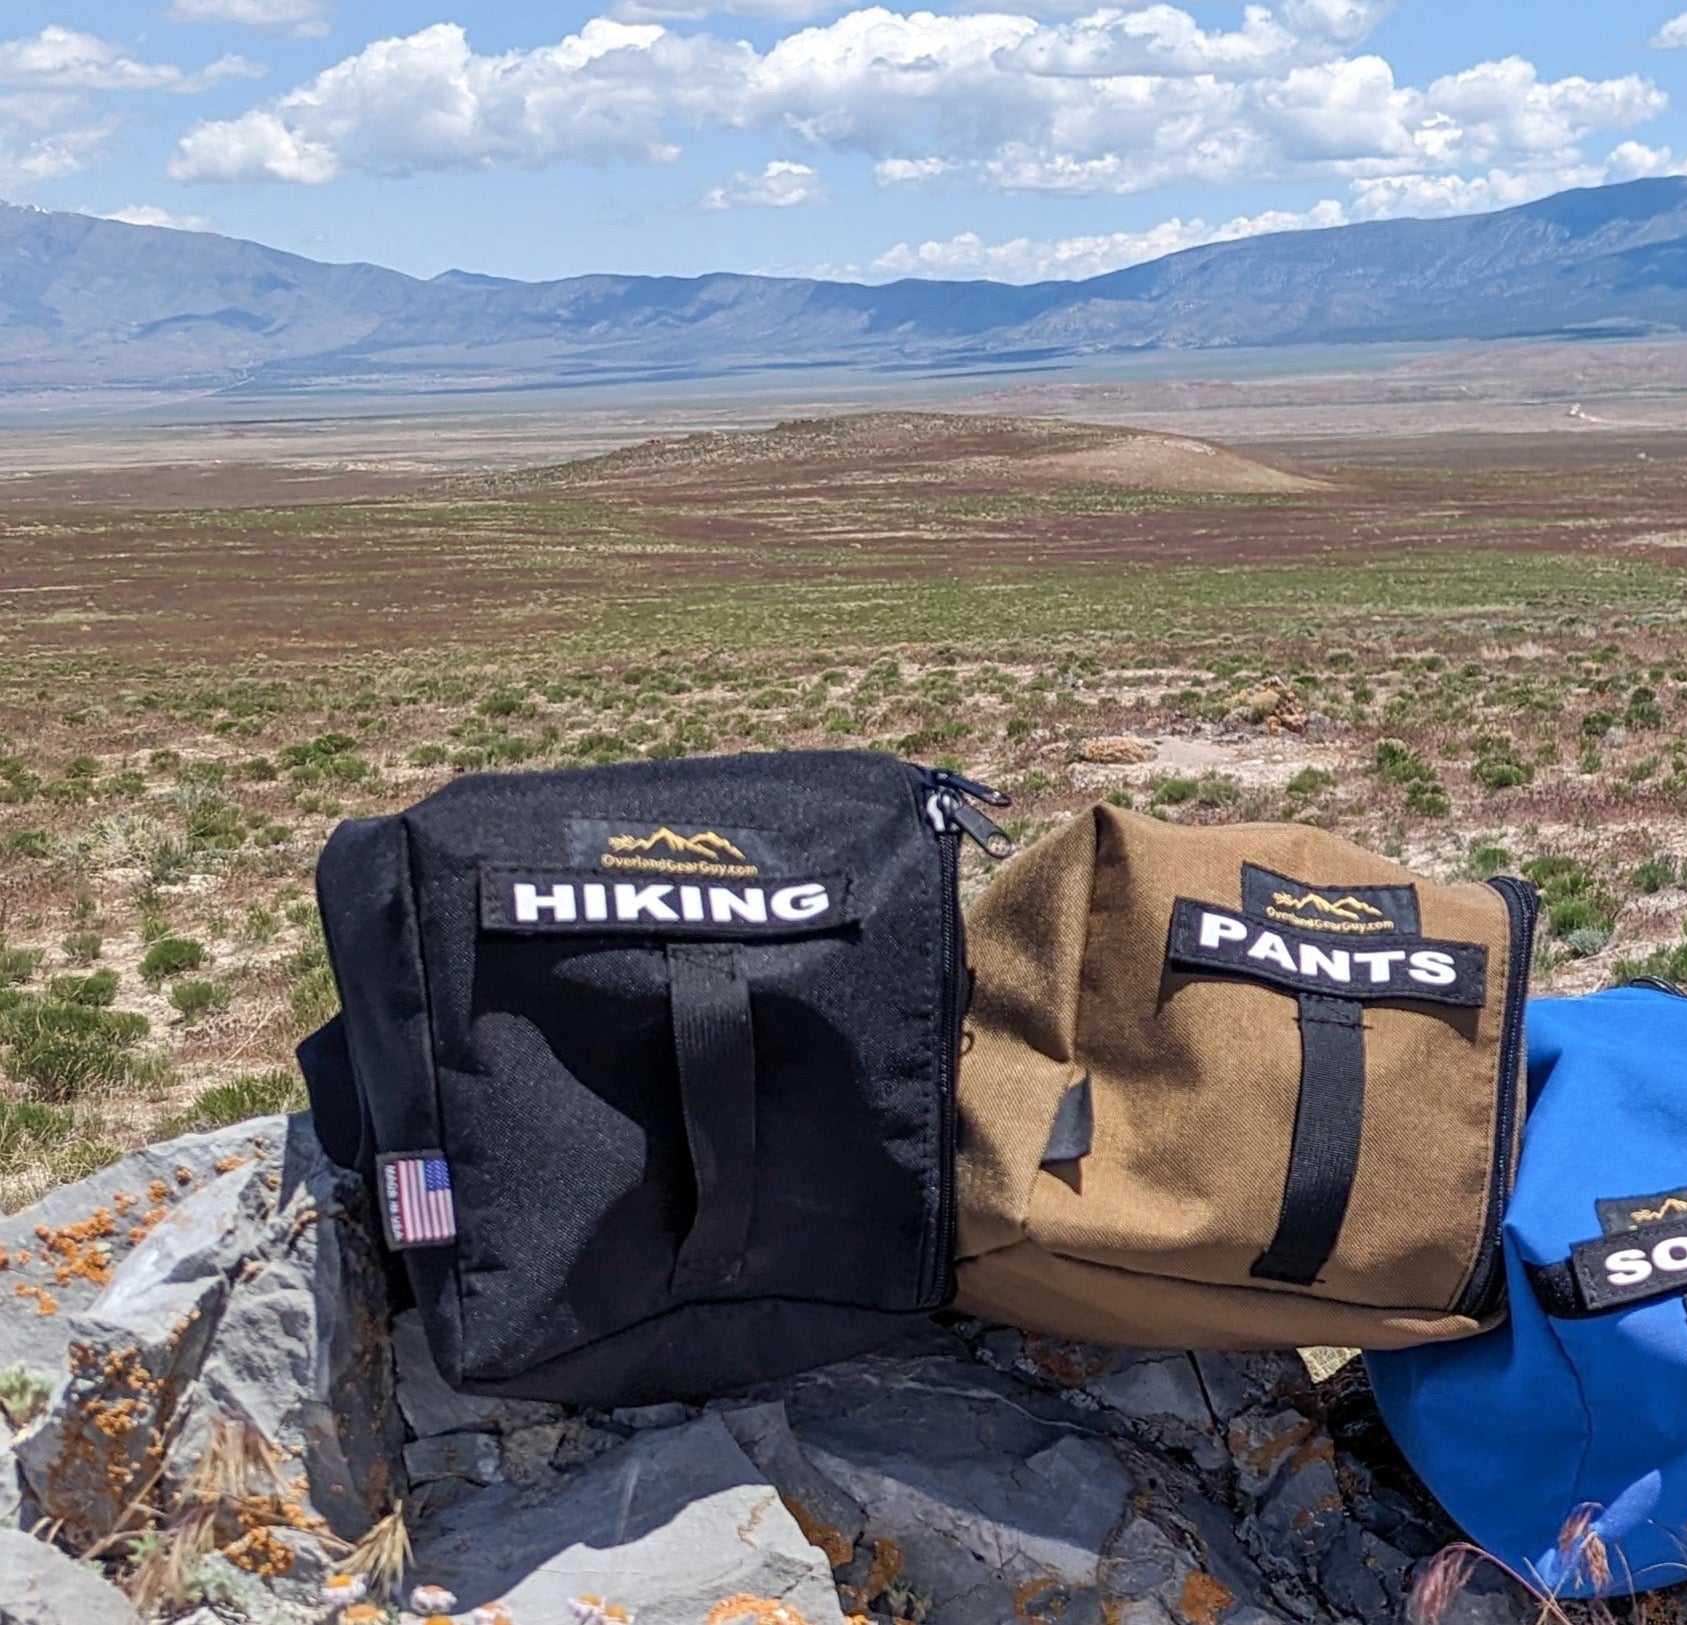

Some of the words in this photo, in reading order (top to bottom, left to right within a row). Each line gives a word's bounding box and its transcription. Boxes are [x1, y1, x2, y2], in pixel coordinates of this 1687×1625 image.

[601, 853, 758, 877] OverlandGearGuy.com
[514, 884, 829, 922] HIKING
[1200, 912, 1456, 984] PANTS
